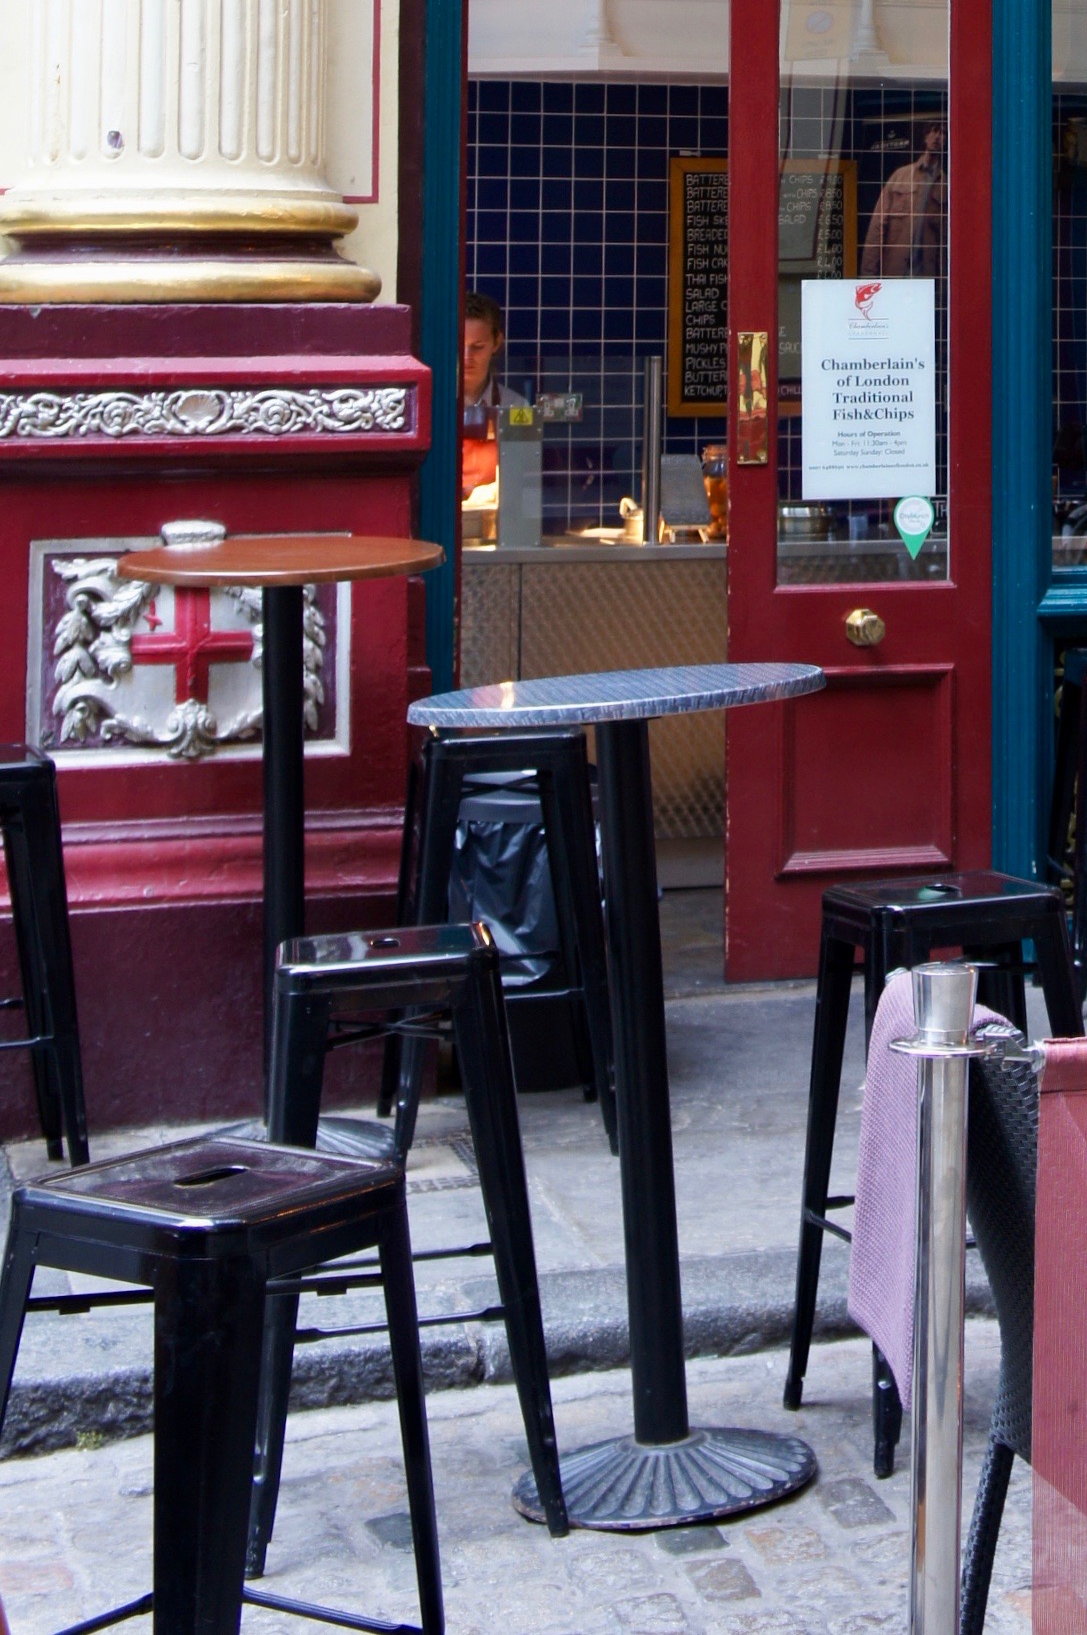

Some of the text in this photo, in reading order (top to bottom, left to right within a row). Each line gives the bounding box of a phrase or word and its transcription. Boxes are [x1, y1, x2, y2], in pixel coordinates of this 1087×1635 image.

[686, 288, 719, 299] SALAD
[686, 314, 715, 325] CHIPS
[821, 358, 925, 371] Chamberlain's
[837, 374, 909, 387] of London
[832, 390, 913, 404] Traditional
[833, 407, 914, 422] Fish&Chips
